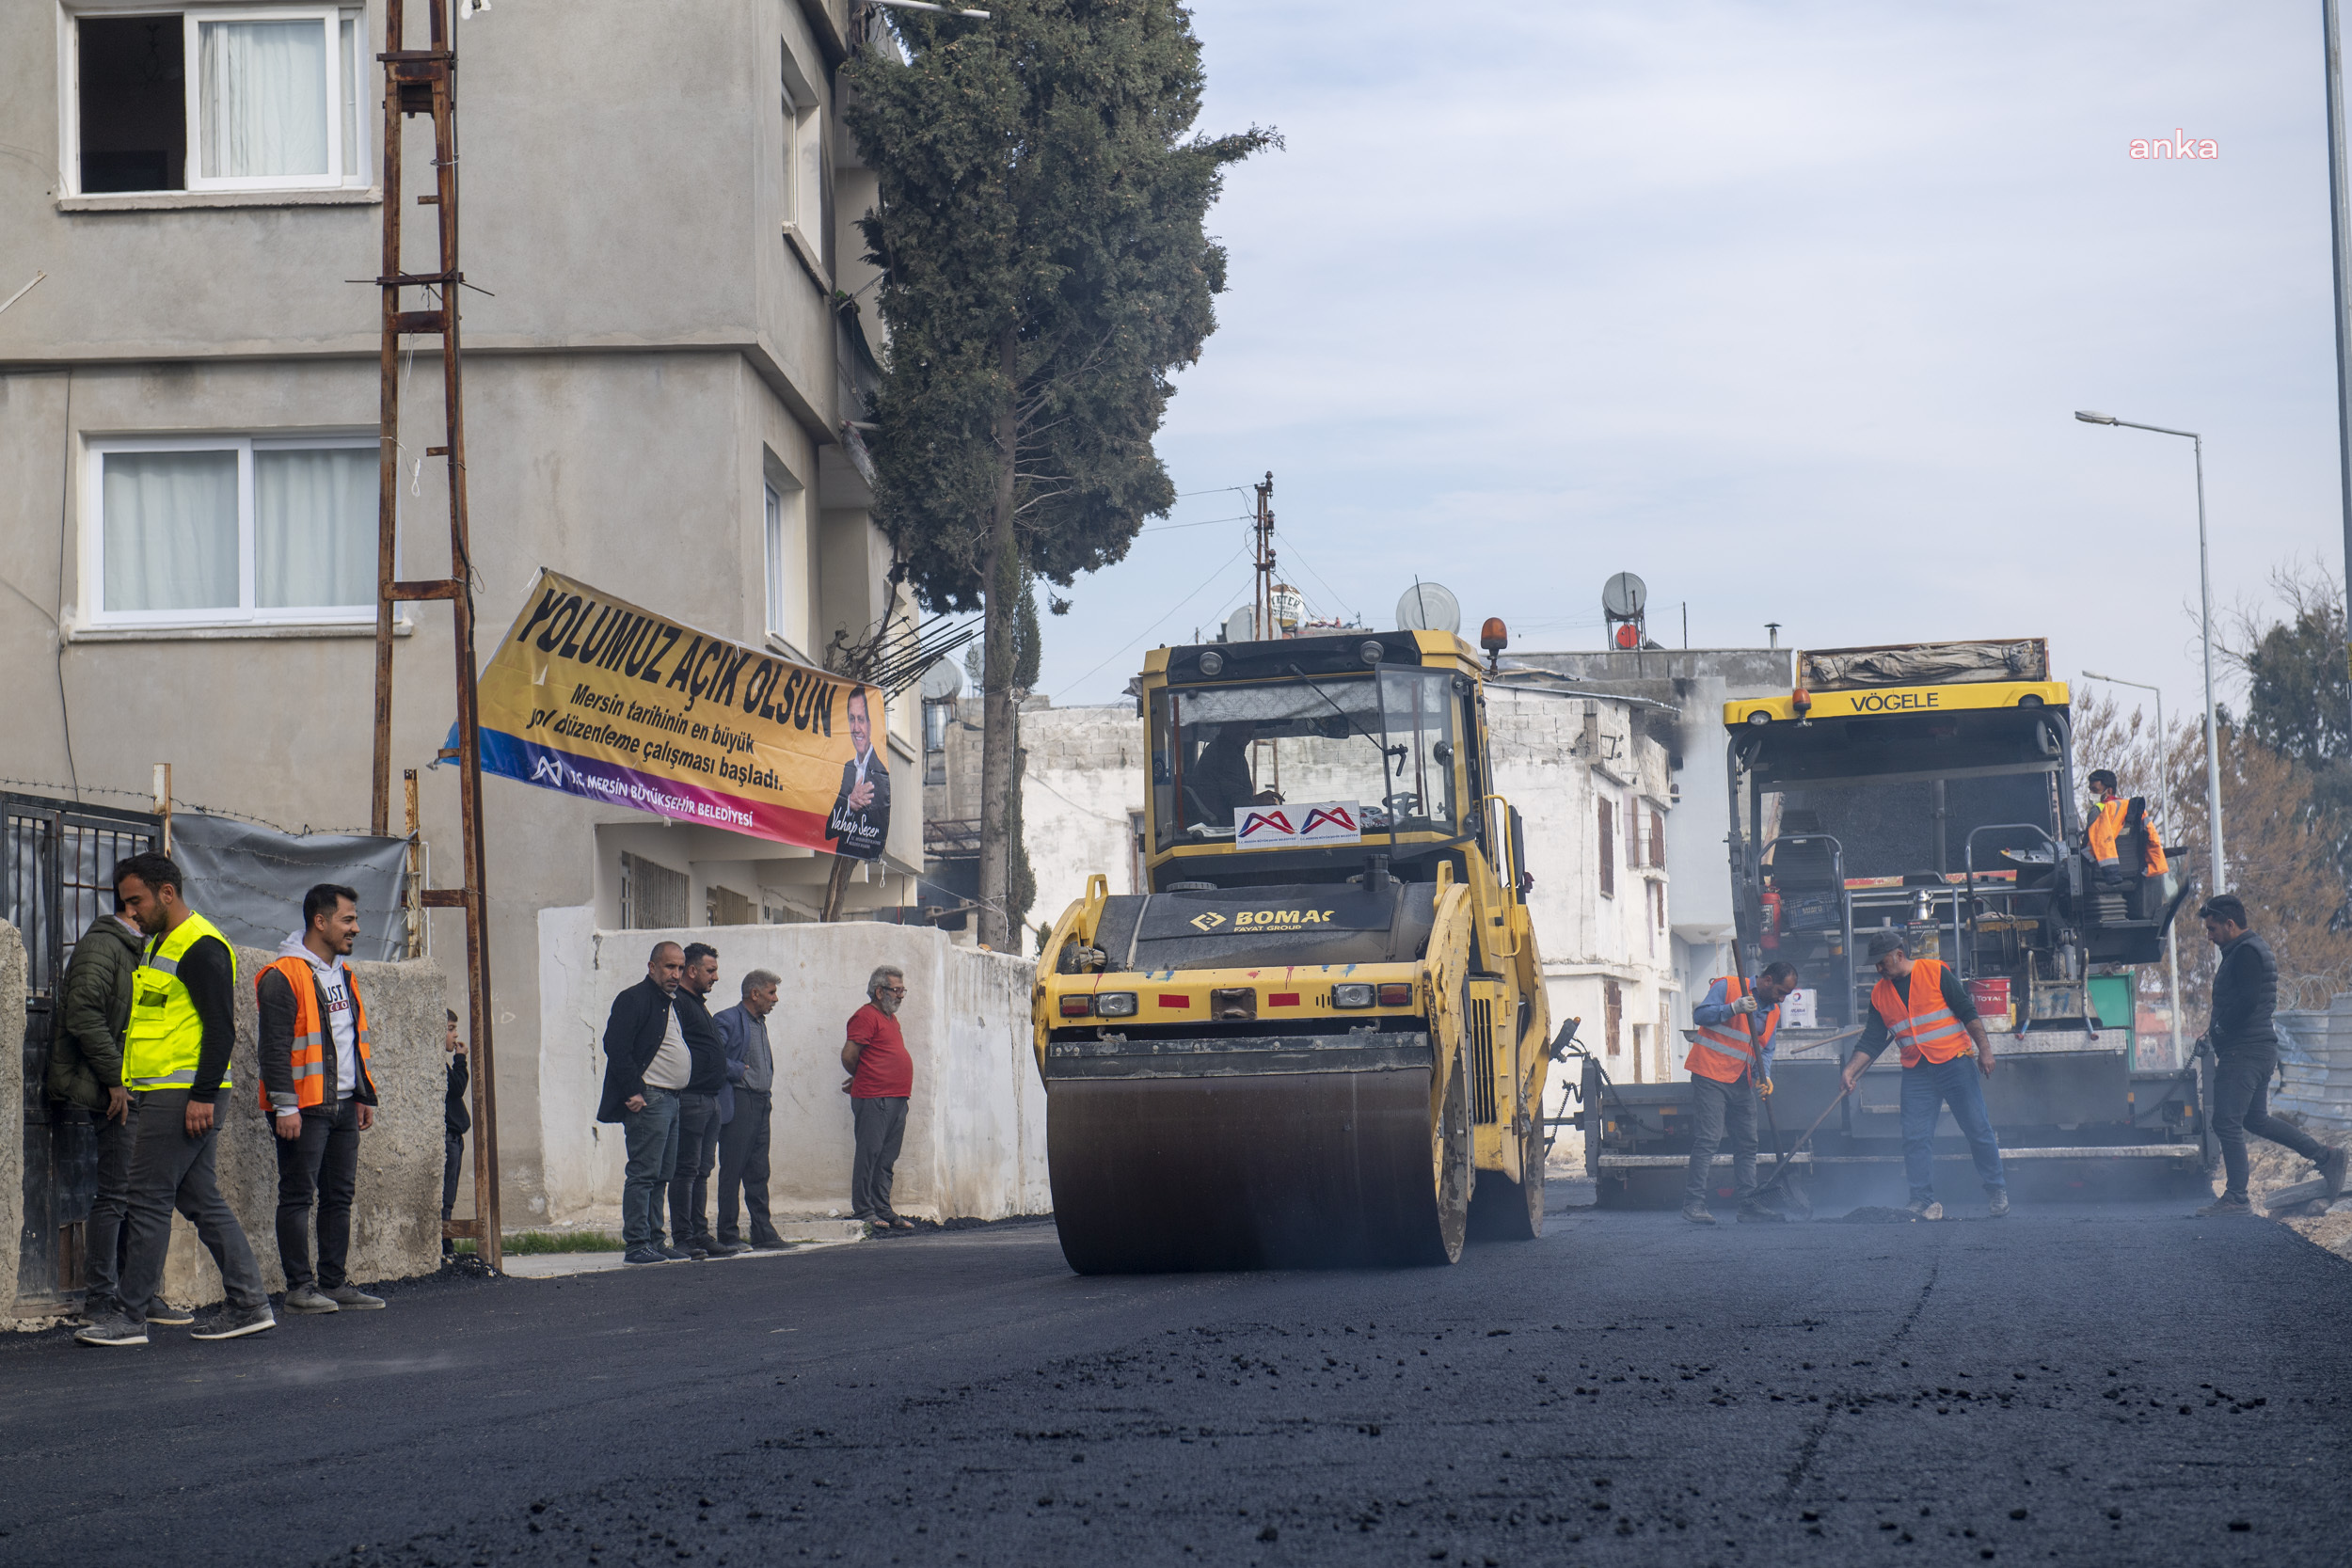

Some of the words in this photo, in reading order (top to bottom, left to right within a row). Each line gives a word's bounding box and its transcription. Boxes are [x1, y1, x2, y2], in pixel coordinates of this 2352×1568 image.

[516, 588, 683, 684] YOLUMUZ
[665, 635, 753, 712] AÇIK
[743, 658, 838, 738] OLSUN
[570, 683, 625, 717] Mersin
[626, 700, 689, 736] tarihinin
[691, 722, 709, 741] en
[711, 723, 755, 754] büyük
[1850, 692, 1939, 712] VÖGELE
[526, 707, 558, 730] yol
[553, 713, 641, 753] düzenleme
[643, 740, 716, 769] çalışması
[719, 756, 784, 791] başladı.
[587, 775, 628, 798] MERSİN
[630, 783, 695, 815] BÜYÜKŞEHİR
[697, 801, 754, 828] BELEDİYESİ
[832, 806, 858, 844] Vahap
[858, 814, 880, 838] Seçer
